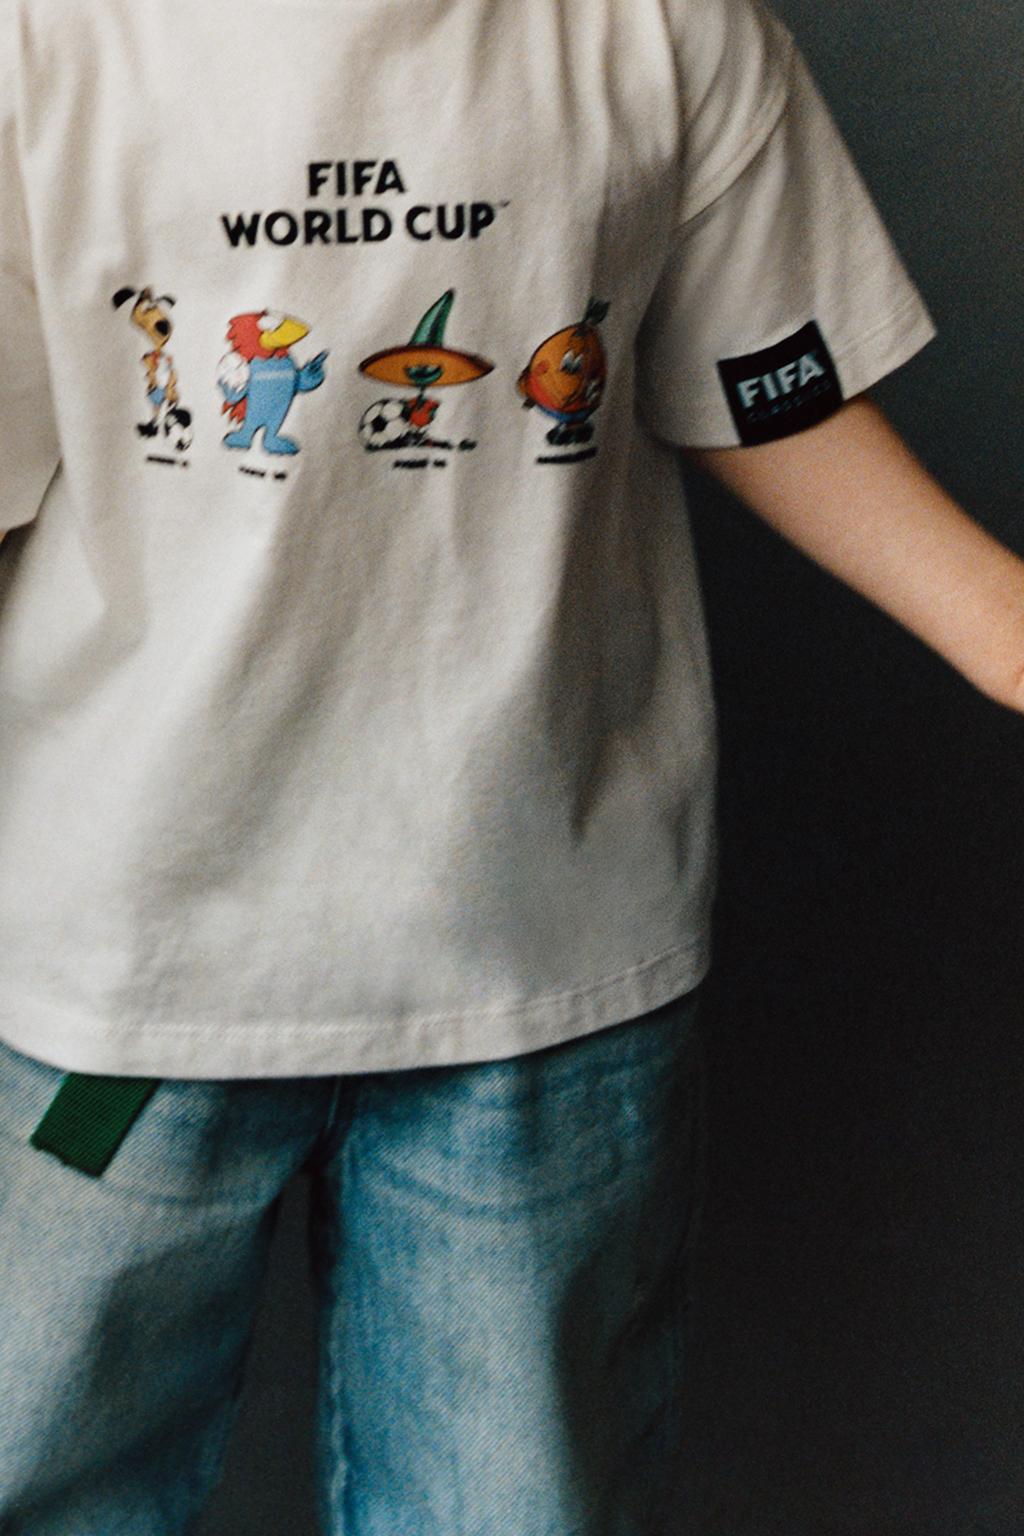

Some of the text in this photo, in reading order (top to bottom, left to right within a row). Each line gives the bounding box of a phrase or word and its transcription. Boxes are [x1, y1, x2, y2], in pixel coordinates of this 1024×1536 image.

[307, 160, 406, 197] FIFA
[221, 202, 495, 247] WORLD CUP
[736, 351, 825, 409] FIFA
